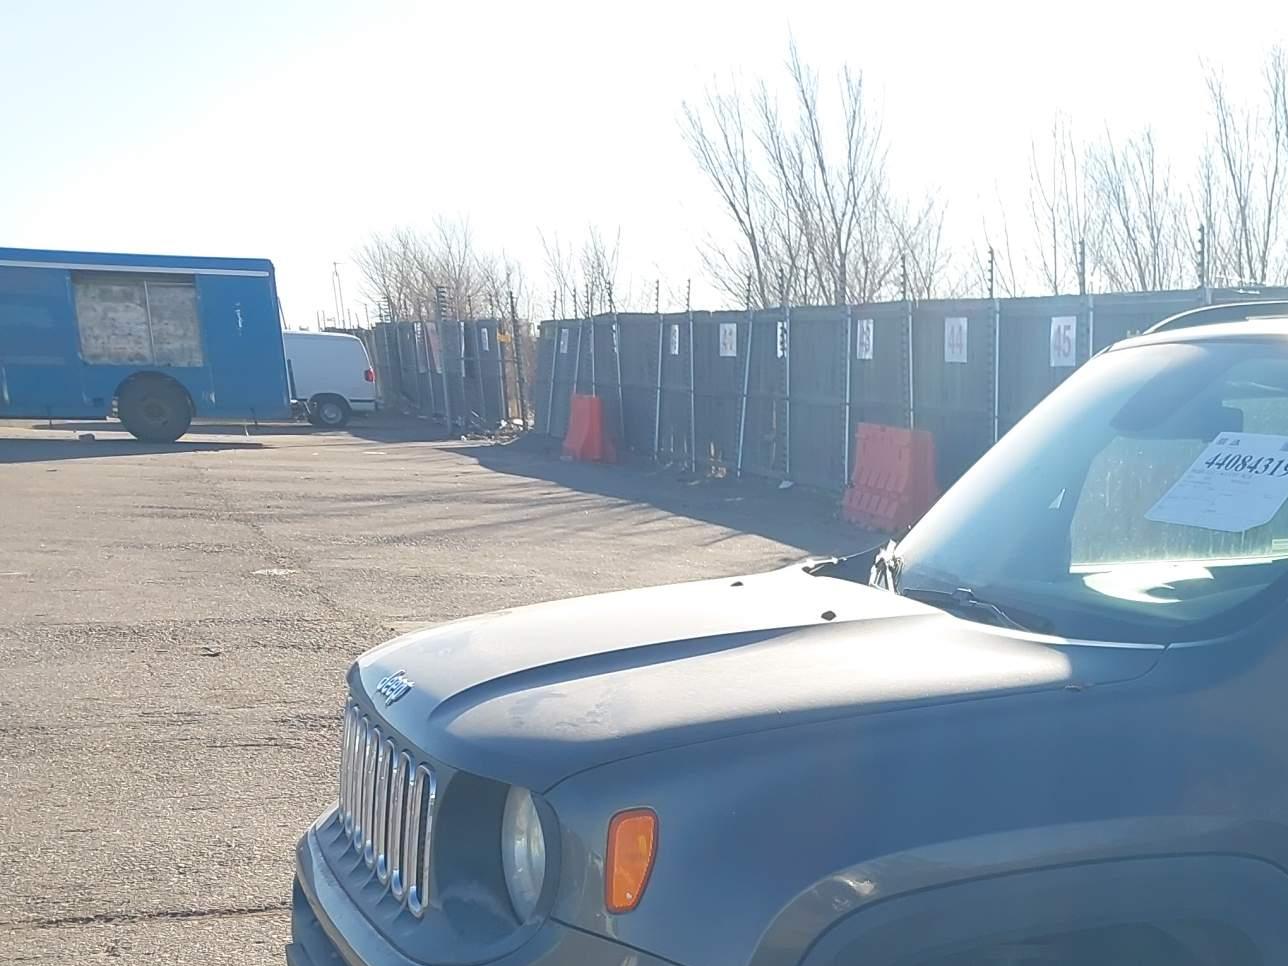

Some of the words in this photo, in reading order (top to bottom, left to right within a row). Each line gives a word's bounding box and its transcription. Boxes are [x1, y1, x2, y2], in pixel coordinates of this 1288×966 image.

[948, 325, 964, 355] 44
[1053, 324, 1072, 357] 45
[377, 669, 415, 707] Jeep
